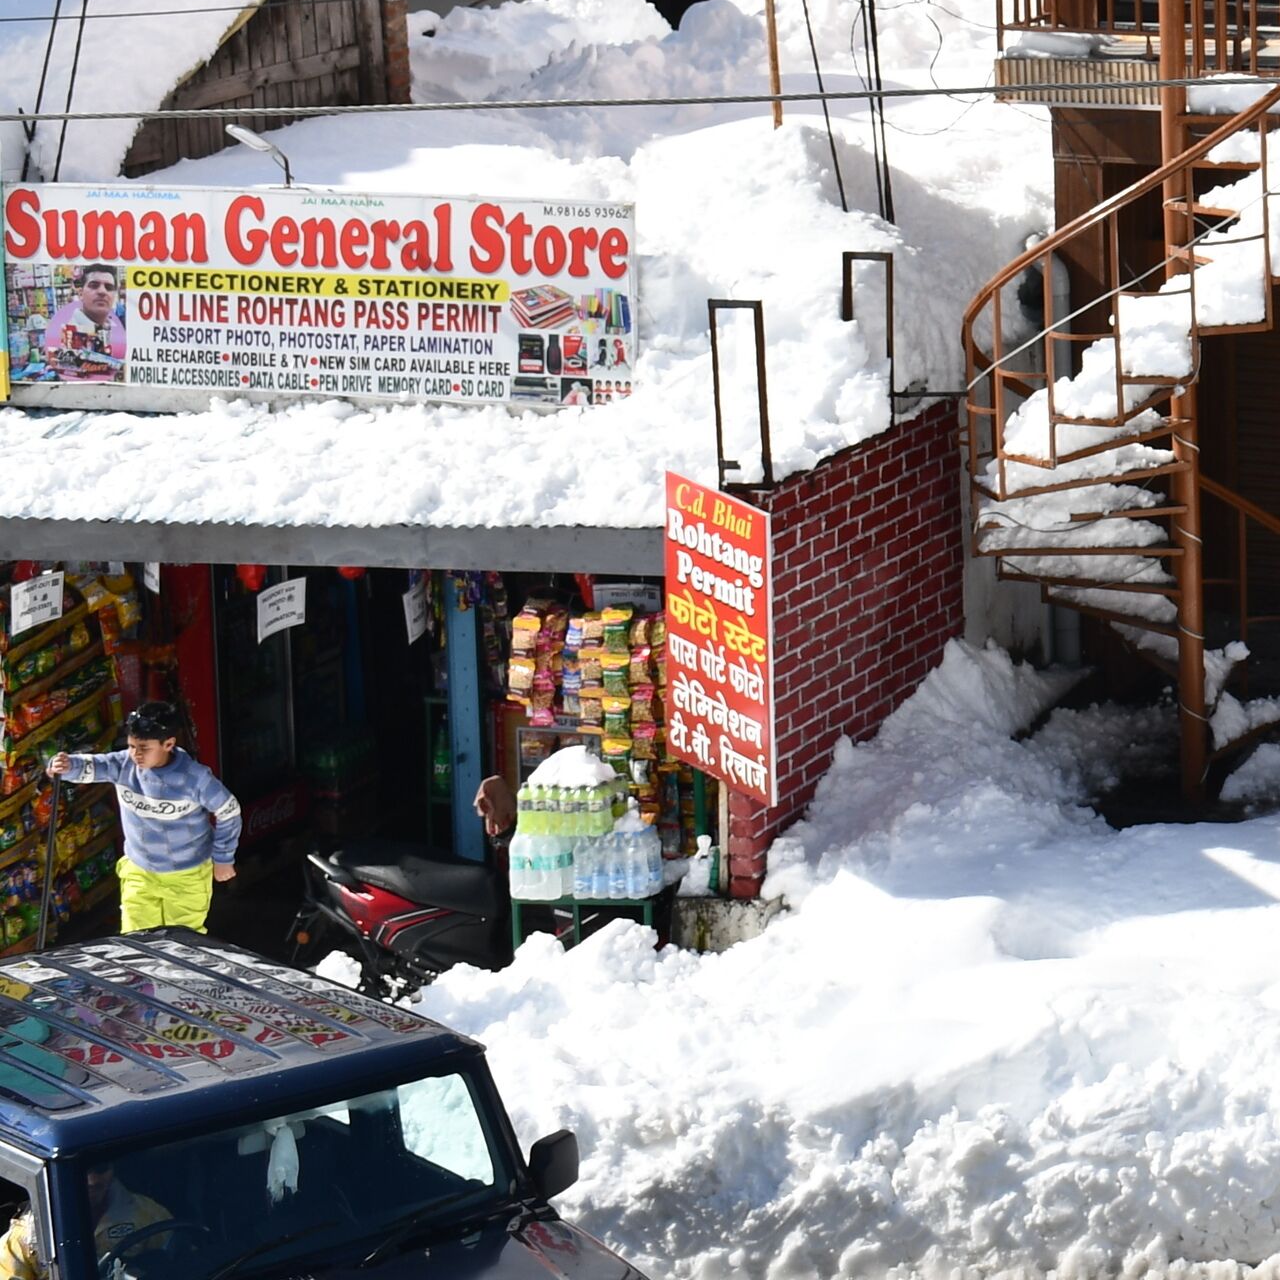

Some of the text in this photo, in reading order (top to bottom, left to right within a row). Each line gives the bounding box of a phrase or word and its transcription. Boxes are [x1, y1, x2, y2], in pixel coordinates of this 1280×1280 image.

[103, 191, 129, 200] MAA
[301, 197, 385, 208] JAI MAA NAINA
[543, 206, 630, 219] M.98165 93962
[5, 188, 629, 279] Suman General Store
[132, 270, 501, 300] CONFECTIONERY & STATIONERY
[138, 291, 502, 333] ON LINE ROHTANG PASS PERMIT
[131, 348, 153, 362] ALL
[157, 348, 221, 365] RECHARGE
[231, 351, 276, 367] MOBILE
[280, 354, 289, 368] &
[293, 354, 309, 369] TV
[319, 355, 346, 370] NEW
[350, 356, 371, 371] SIM
[374, 357, 406, 372] CARD
[410, 358, 475, 375] AVAILABLE
[479, 361, 511, 376] HERE
[153, 326, 493, 356] PASSPORT PHOTO, PHOTOSTAT, PAPER LAMINATION
[130, 366, 505, 398] MOBILE ACCESSORIES DATA CABLE PEN DRIVE MEMORY CARD SD CARD
[674, 483, 753, 541] C.d. Bhai
[667, 507, 764, 588] Rohtang
[676, 550, 756, 616] Permit
[668, 590, 767, 663] फोटो स्टेट
[668, 632, 765, 705] पास पोर्ट फोटो
[672, 672, 763, 750] लेमिनेशन
[718, 734, 768, 796] रिचार्ज
